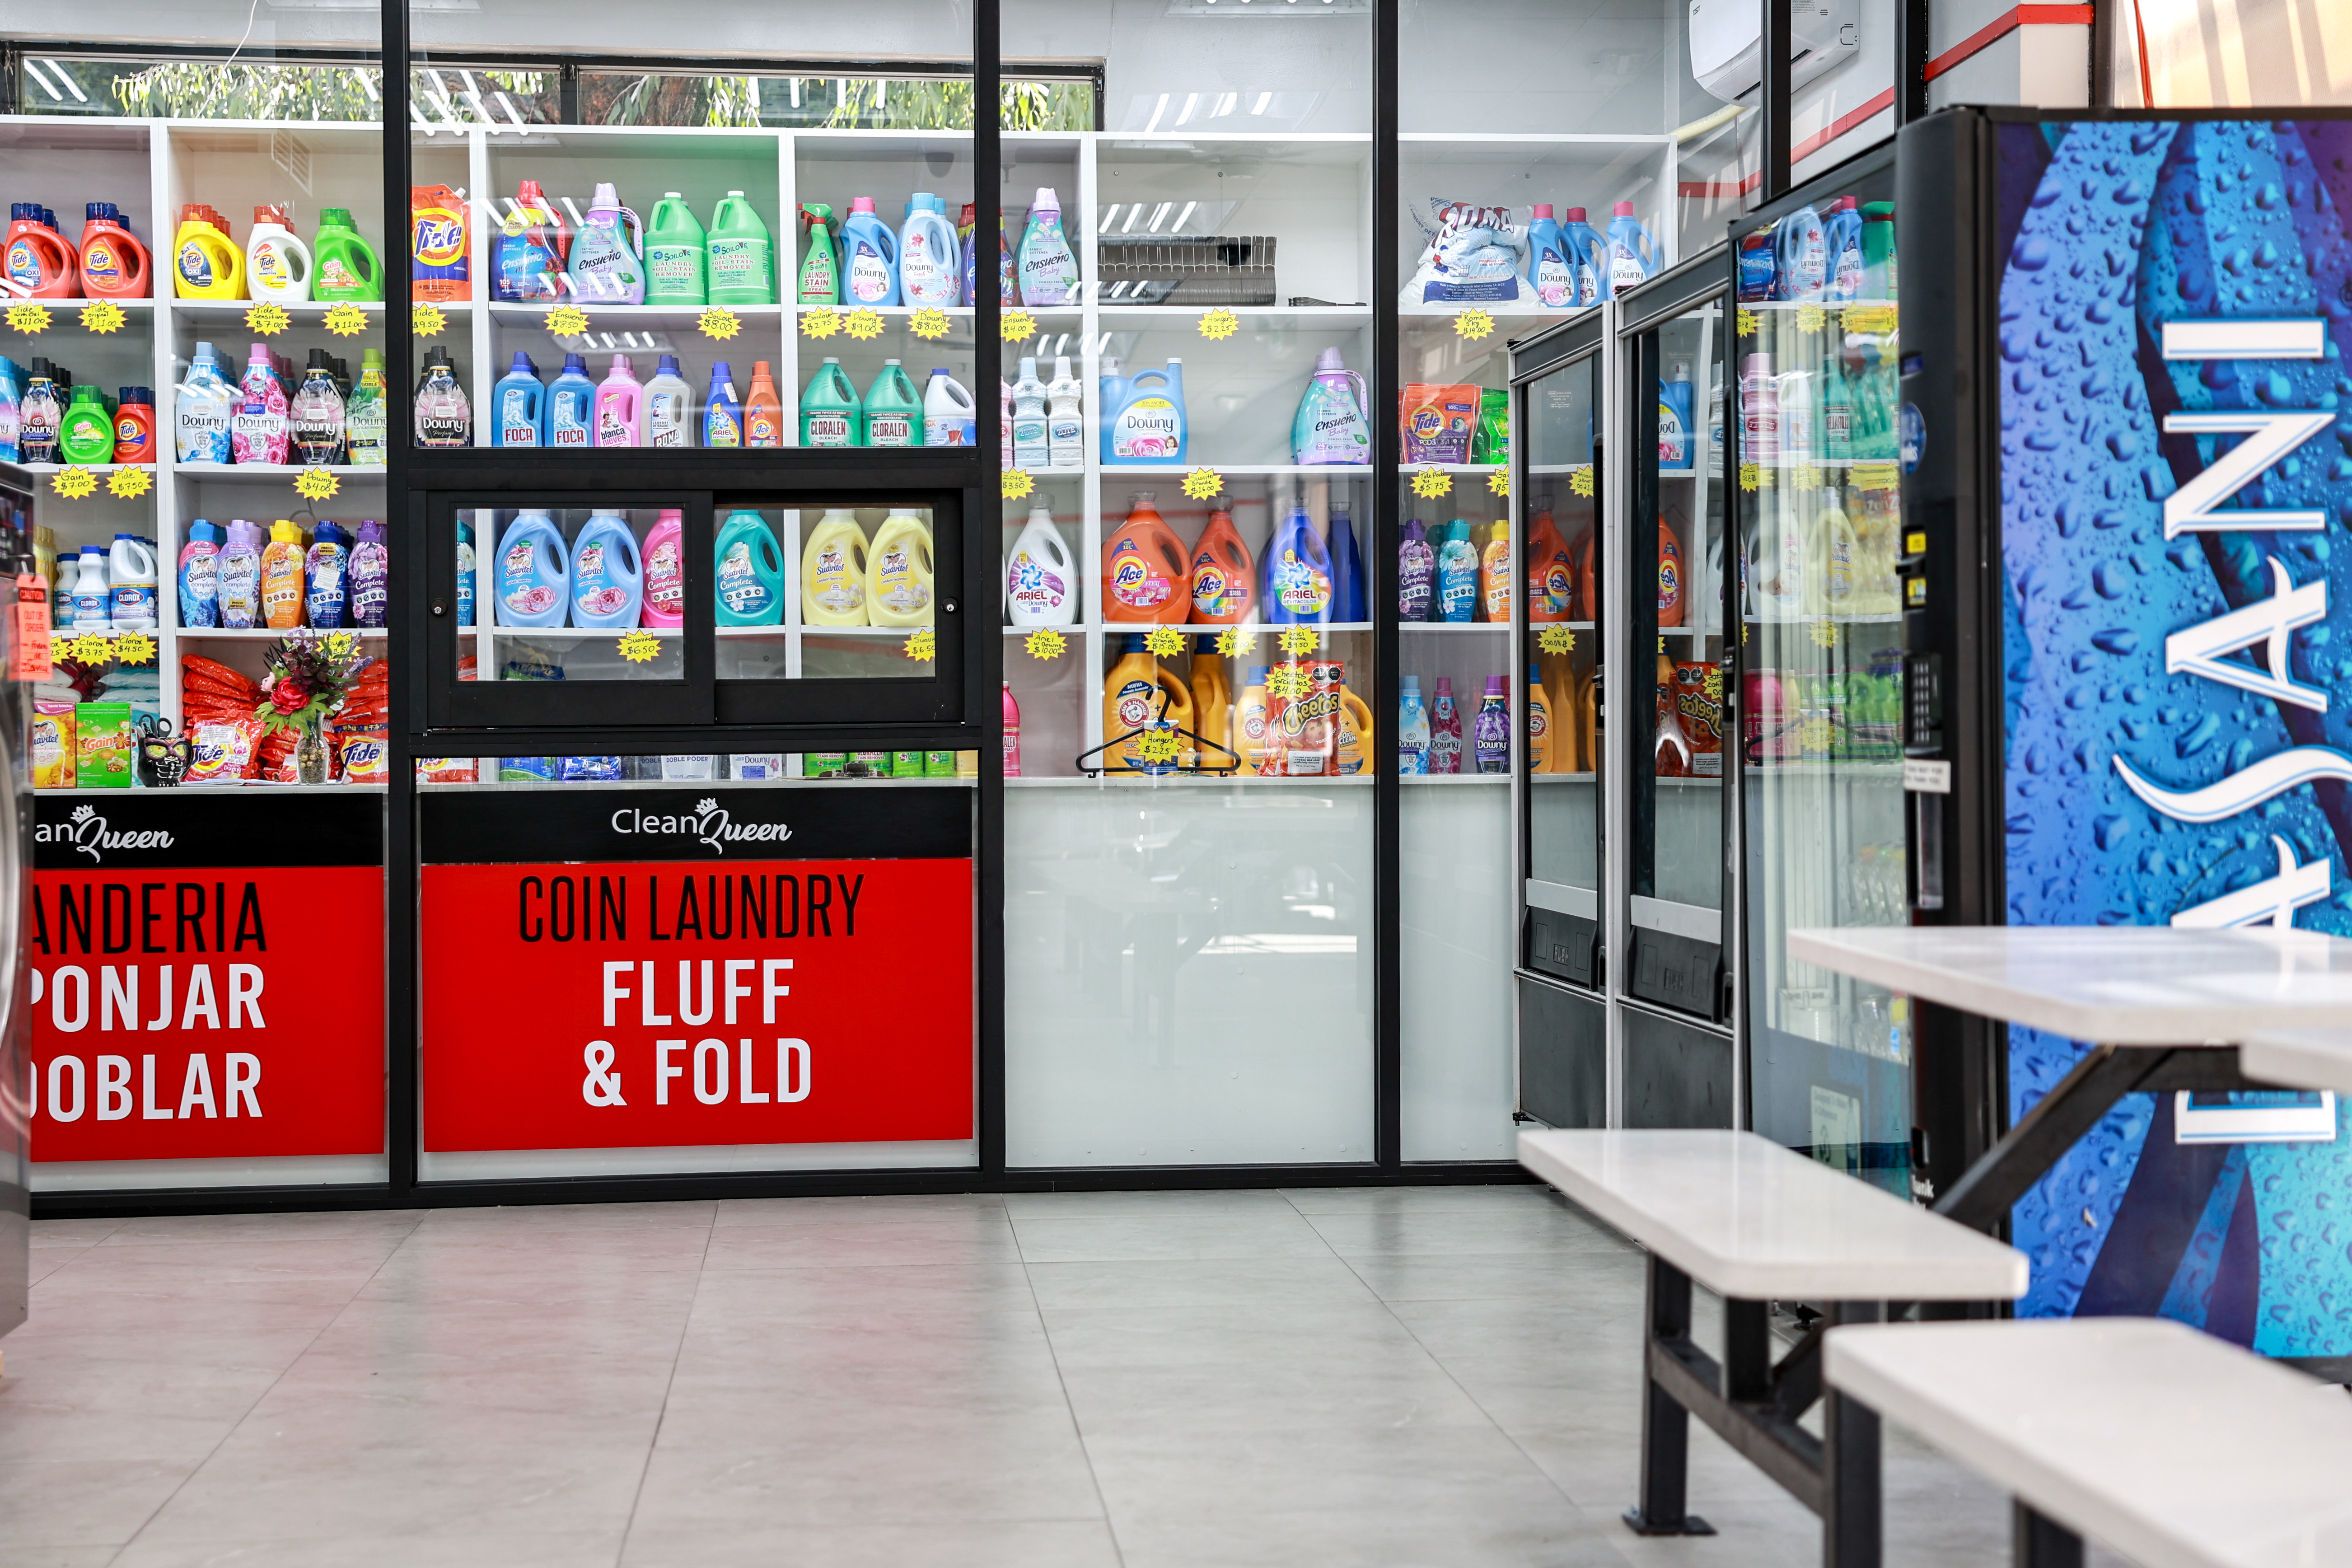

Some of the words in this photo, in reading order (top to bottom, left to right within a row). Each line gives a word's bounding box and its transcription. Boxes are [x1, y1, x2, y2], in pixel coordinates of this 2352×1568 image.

[415, 219, 462, 257] Tide
[12, 254, 27, 266] Tide
[90, 254, 108, 266] Tide
[186, 255, 201, 265] Tide
[260, 257, 275, 267] Tide
[323, 261, 341, 271] Gain
[579, 249, 621, 271] ensueño
[1025, 251, 1069, 272] ensueño
[906, 263, 933, 272] Downy
[855, 267, 886, 281] Downy
[1540, 274, 1570, 286] Downy
[333, 309, 353, 317] Gain
[854, 314, 877, 323] Downy
[89, 318, 116, 327] $11.00
[334, 321, 362, 329] $11.00
[704, 318, 732, 331] $8.00
[808, 321, 832, 330] $2.75
[921, 313, 947, 326] Downy
[1209, 316, 1233, 324] Hangers
[851, 323, 876, 332] $9.00
[916, 322, 942, 331] $8.00
[1463, 326, 1485, 335] $14.00
[74, 422, 92, 431] Gain
[182, 415, 224, 430] Downy
[238, 417, 280, 432] Downy
[423, 417, 463, 432] Downy
[1127, 416, 1173, 433] Downy
[1315, 411, 1356, 431] ensueño
[1413, 413, 1440, 433] Tide
[23, 425, 54, 436] Downy
[120, 425, 135, 438] Tide
[296, 421, 336, 435] Downy
[601, 428, 625, 440] blanca
[754, 425, 770, 435] Ace
[811, 421, 846, 435] CLORALEN
[872, 422, 907, 437] CLORALEN
[1057, 426, 1076, 436] ZOTE
[505, 428, 533, 441] FOCA
[557, 431, 584, 444] FOCA
[603, 434, 627, 446] nieves
[656, 429, 679, 447] ROMA
[61, 473, 84, 481] Gain
[307, 473, 332, 483] Downy
[1190, 474, 1213, 483] Suavitel
[61, 481, 90, 490] $7.00
[118, 482, 143, 491] $7.50
[1003, 481, 1024, 489] $3.50
[1191, 486, 1214, 494] $16.00
[1419, 482, 1445, 491] $5.75
[505, 565, 533, 578] Suavitel
[578, 566, 603, 580] Suavitel
[724, 567, 748, 580] Suavitel
[817, 564, 845, 576] Suavitel
[881, 564, 908, 576] Suavitel
[1115, 566, 1143, 584] Ace
[224, 571, 253, 583] Suavitel
[720, 579, 753, 590] Complete
[1196, 576, 1222, 594] Ace
[1016, 591, 1047, 601] ARIEL
[1283, 590, 1316, 599] ARIEL
[79, 639, 103, 647] Clorox
[1225, 641, 1249, 650] $10.00
[77, 647, 104, 656] $3.75
[627, 646, 655, 655] $6.50
[1276, 671, 1306, 679] Cheetos
[1271, 678, 1308, 688] Torciditos
[1274, 687, 1301, 695] $4.00
[1132, 701, 1147, 716] HAMMER
[1285, 695, 1338, 733] Cheetos
[85, 738, 113, 751] Gain
[1147, 734, 1174, 747] Hangers
[1431, 740, 1459, 750] Downy
[1478, 740, 1506, 750] Downy
[342, 743, 380, 768] Tide
[1144, 745, 1170, 754] $2.25
[519, 875, 626, 942] COIN
[650, 874, 865, 941] LAUNDRY
[604, 959, 794, 1026] FLUFF
[583, 1040, 627, 1107] &
[656, 1038, 812, 1105] FOLD
[31, 1052, 263, 1122] OBLAR
